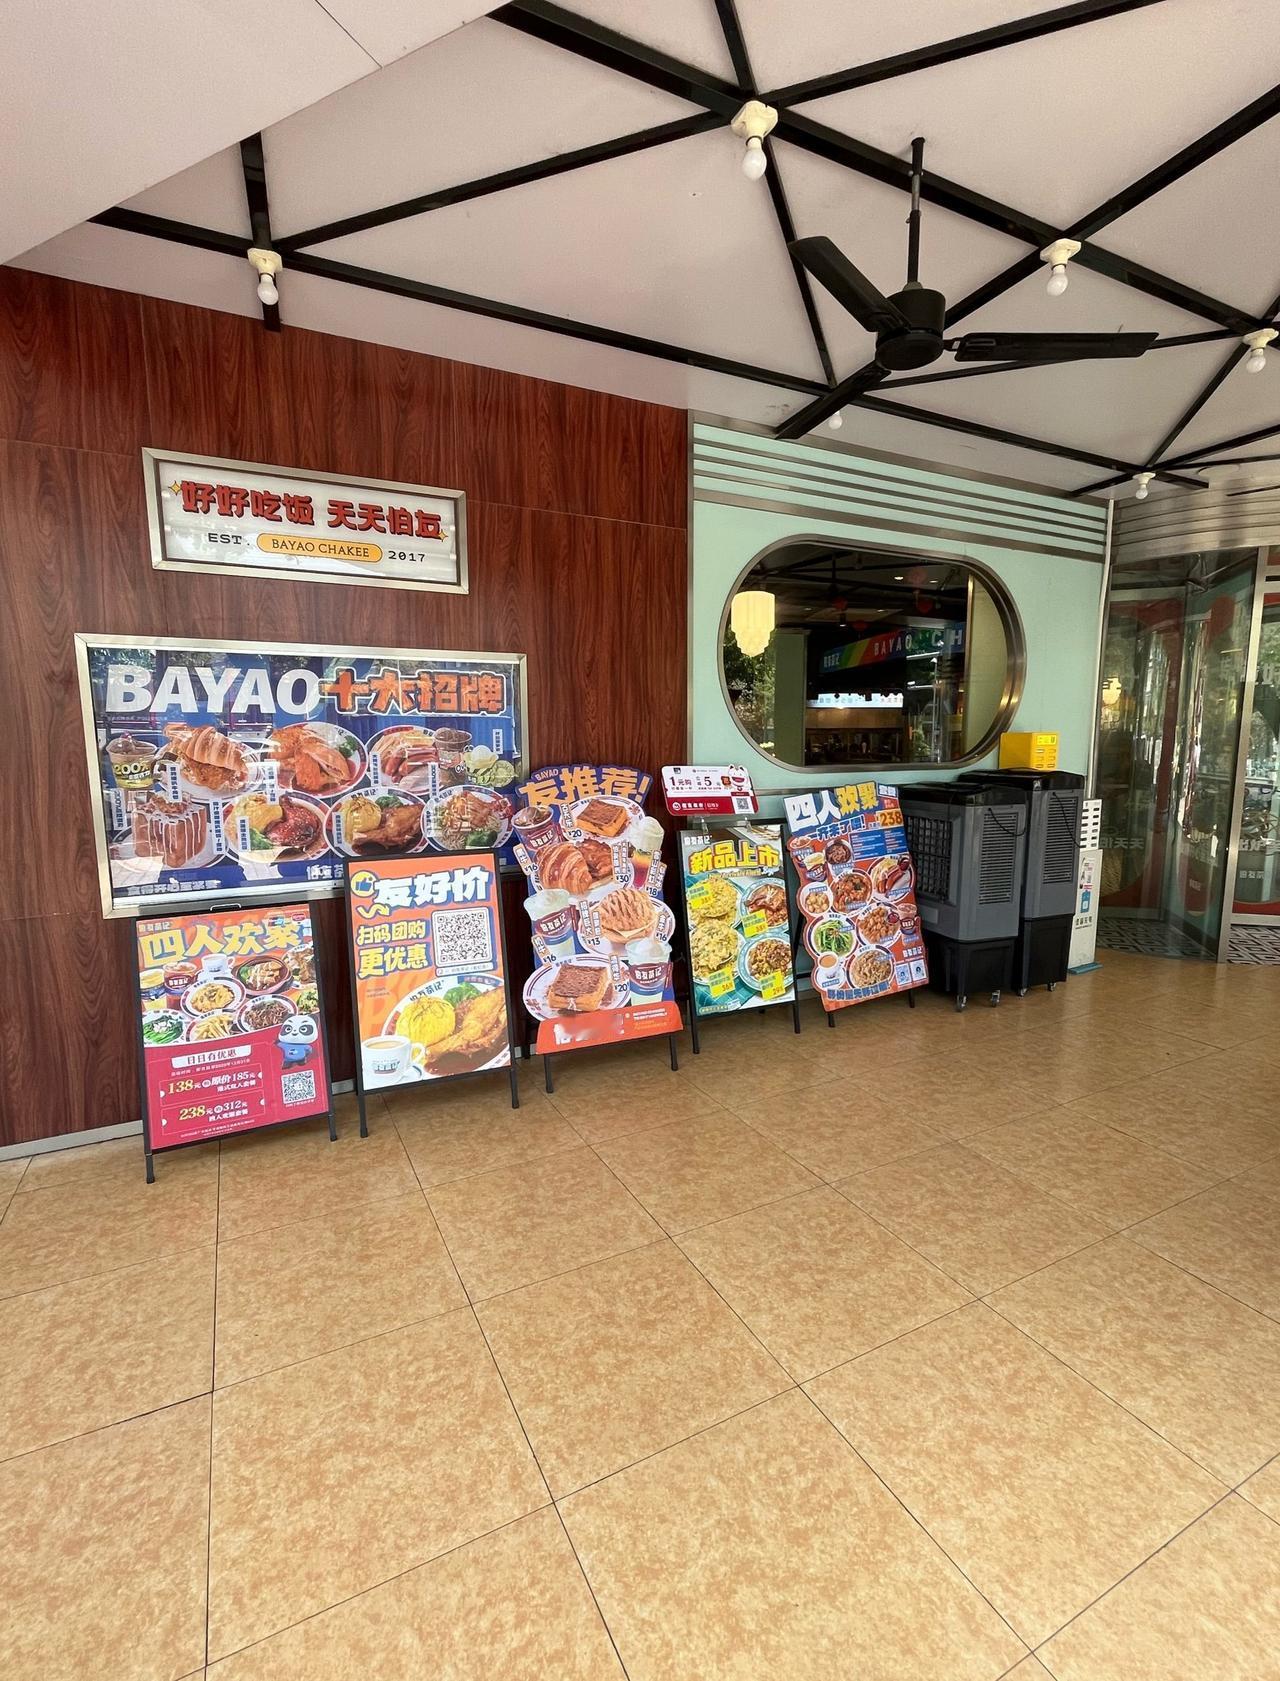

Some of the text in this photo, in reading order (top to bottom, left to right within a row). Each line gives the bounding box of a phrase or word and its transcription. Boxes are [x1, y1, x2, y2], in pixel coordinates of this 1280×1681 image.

[180, 480, 442, 540] 好好吃饭 天天伯友
[208, 532, 251, 546] EST.
[272, 538, 369, 557] BAYAO CHAKEE
[388, 550, 426, 562] 2017
[105, 664, 505, 714] BAYAO 十大招牌
[535, 769, 559, 781] BAYAO
[784, 781, 879, 833] 四人欢聚
[880, 811, 903, 827] 238
[689, 841, 780, 875] 新品上市
[374, 866, 490, 907] 友好价
[356, 920, 427, 945] 扫码团购
[358, 944, 429, 978] 更优惠
[187, 1049, 237, 1065] 日日有优惠
